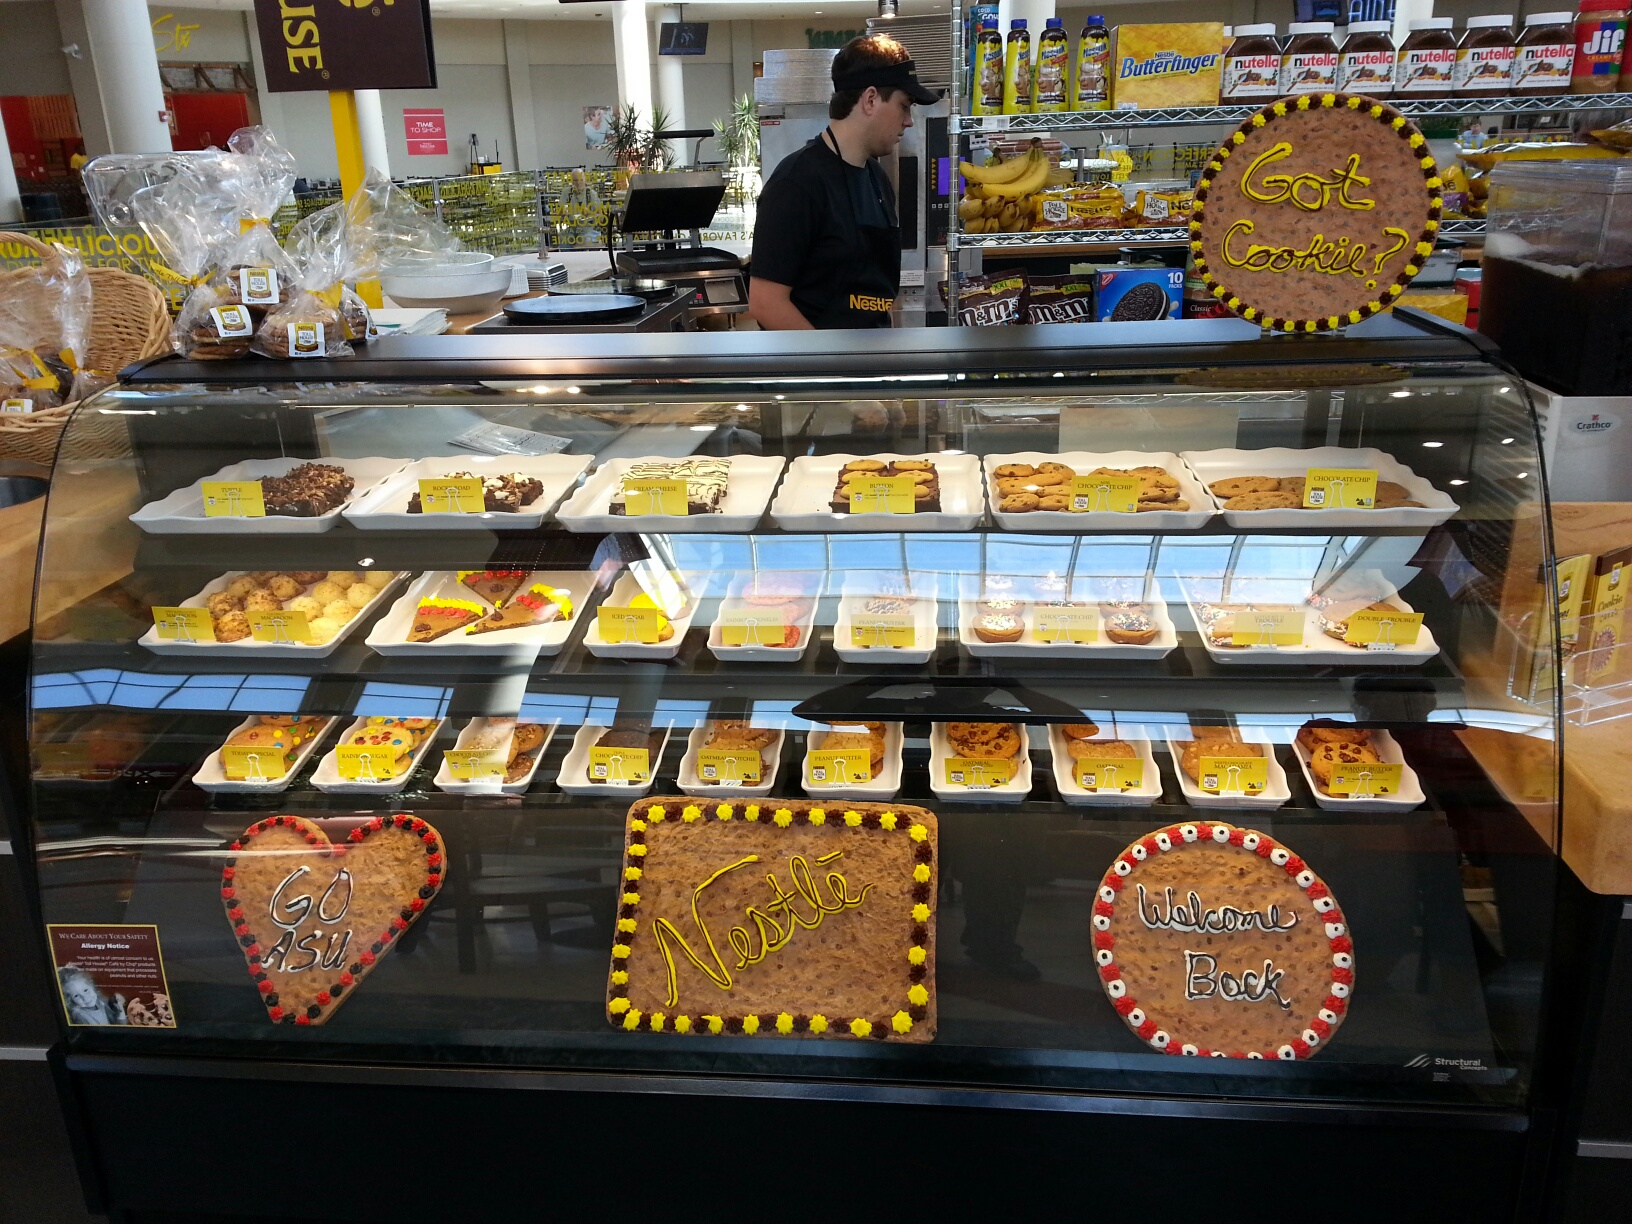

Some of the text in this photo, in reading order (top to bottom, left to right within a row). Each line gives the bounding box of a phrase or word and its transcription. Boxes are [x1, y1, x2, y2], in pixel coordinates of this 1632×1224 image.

[1582, 29, 1625, 54] Jif
[1294, 53, 1337, 67] nutella
[1348, 50, 1394, 66] nutella
[1410, 49, 1455, 63] nutella
[1471, 47, 1515, 62] nutella
[1525, 44, 1574, 60] nutella
[1120, 54, 1219, 78] Butterfinger
[1235, 55, 1279, 69] nutella
[1240, 142, 1376, 212] Got
[1221, 219, 1410, 290] Cookie?
[1168, 272, 1183, 283] 10
[1577, 422, 1611, 430] Crathco
[269, 865, 353, 929] GO
[1136, 883, 1300, 933] Welcome
[262, 928, 353, 973] ASU
[1435, 1058, 1481, 1066] Structural
